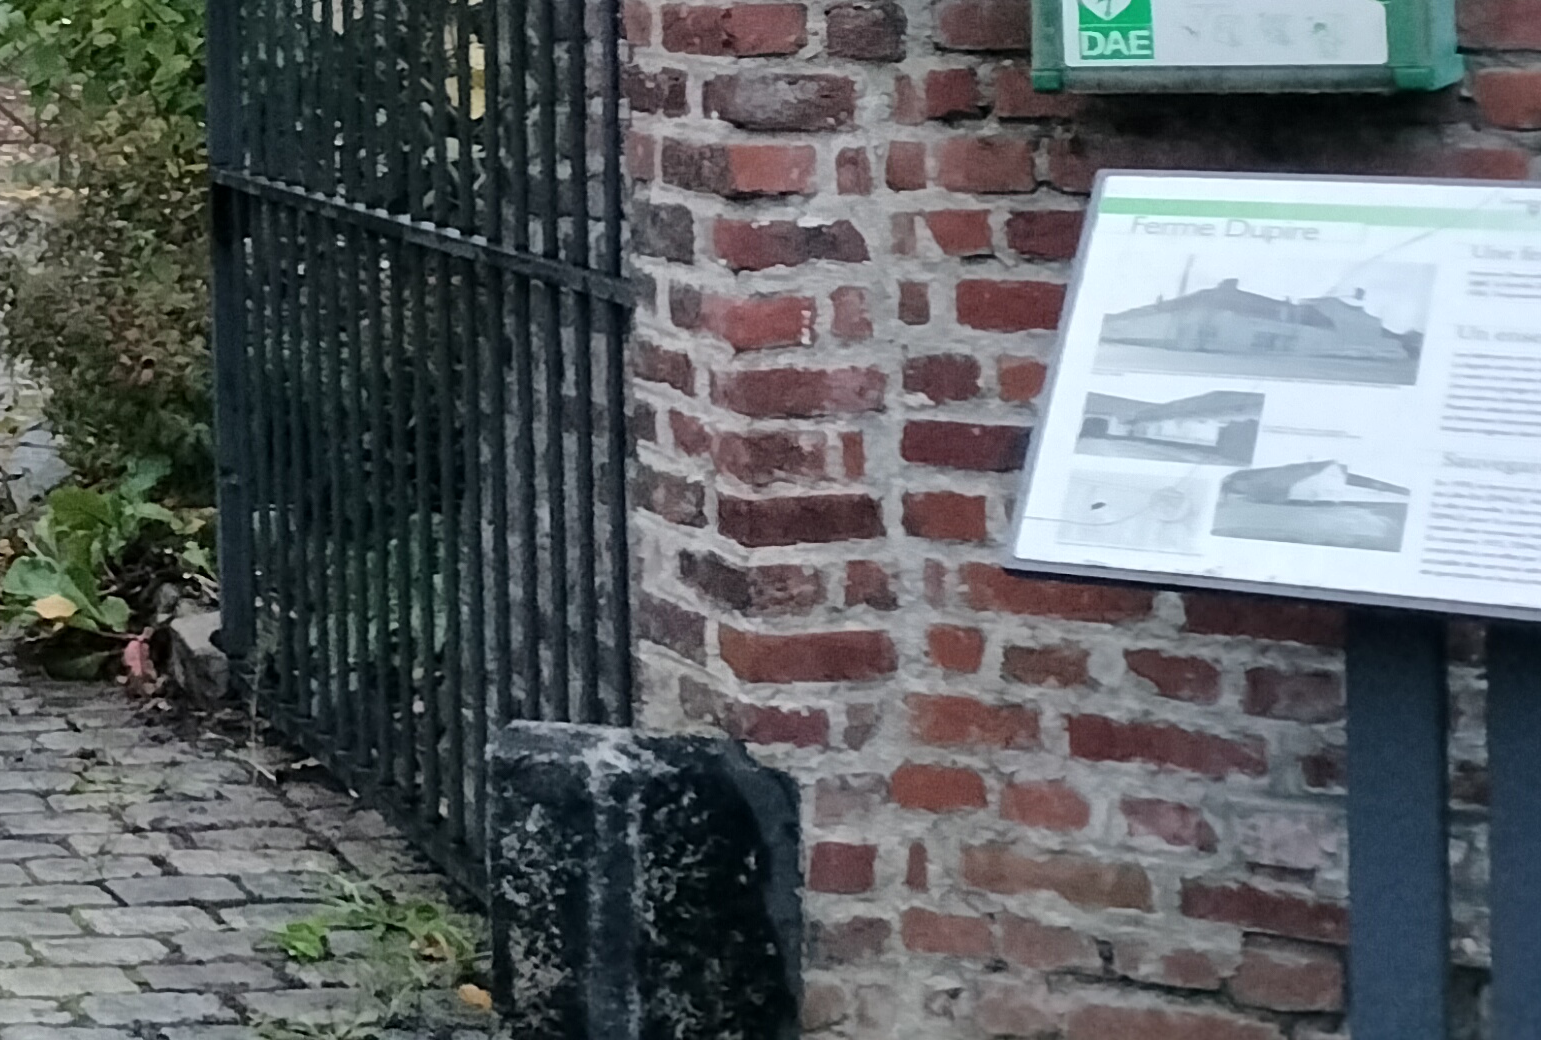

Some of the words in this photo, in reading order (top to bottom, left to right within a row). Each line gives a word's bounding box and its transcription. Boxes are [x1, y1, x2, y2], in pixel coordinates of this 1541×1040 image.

[1081, 30, 1152, 56] DAE
[1130, 215, 1216, 237] Ferme
[1224, 218, 1320, 244] Dupire
